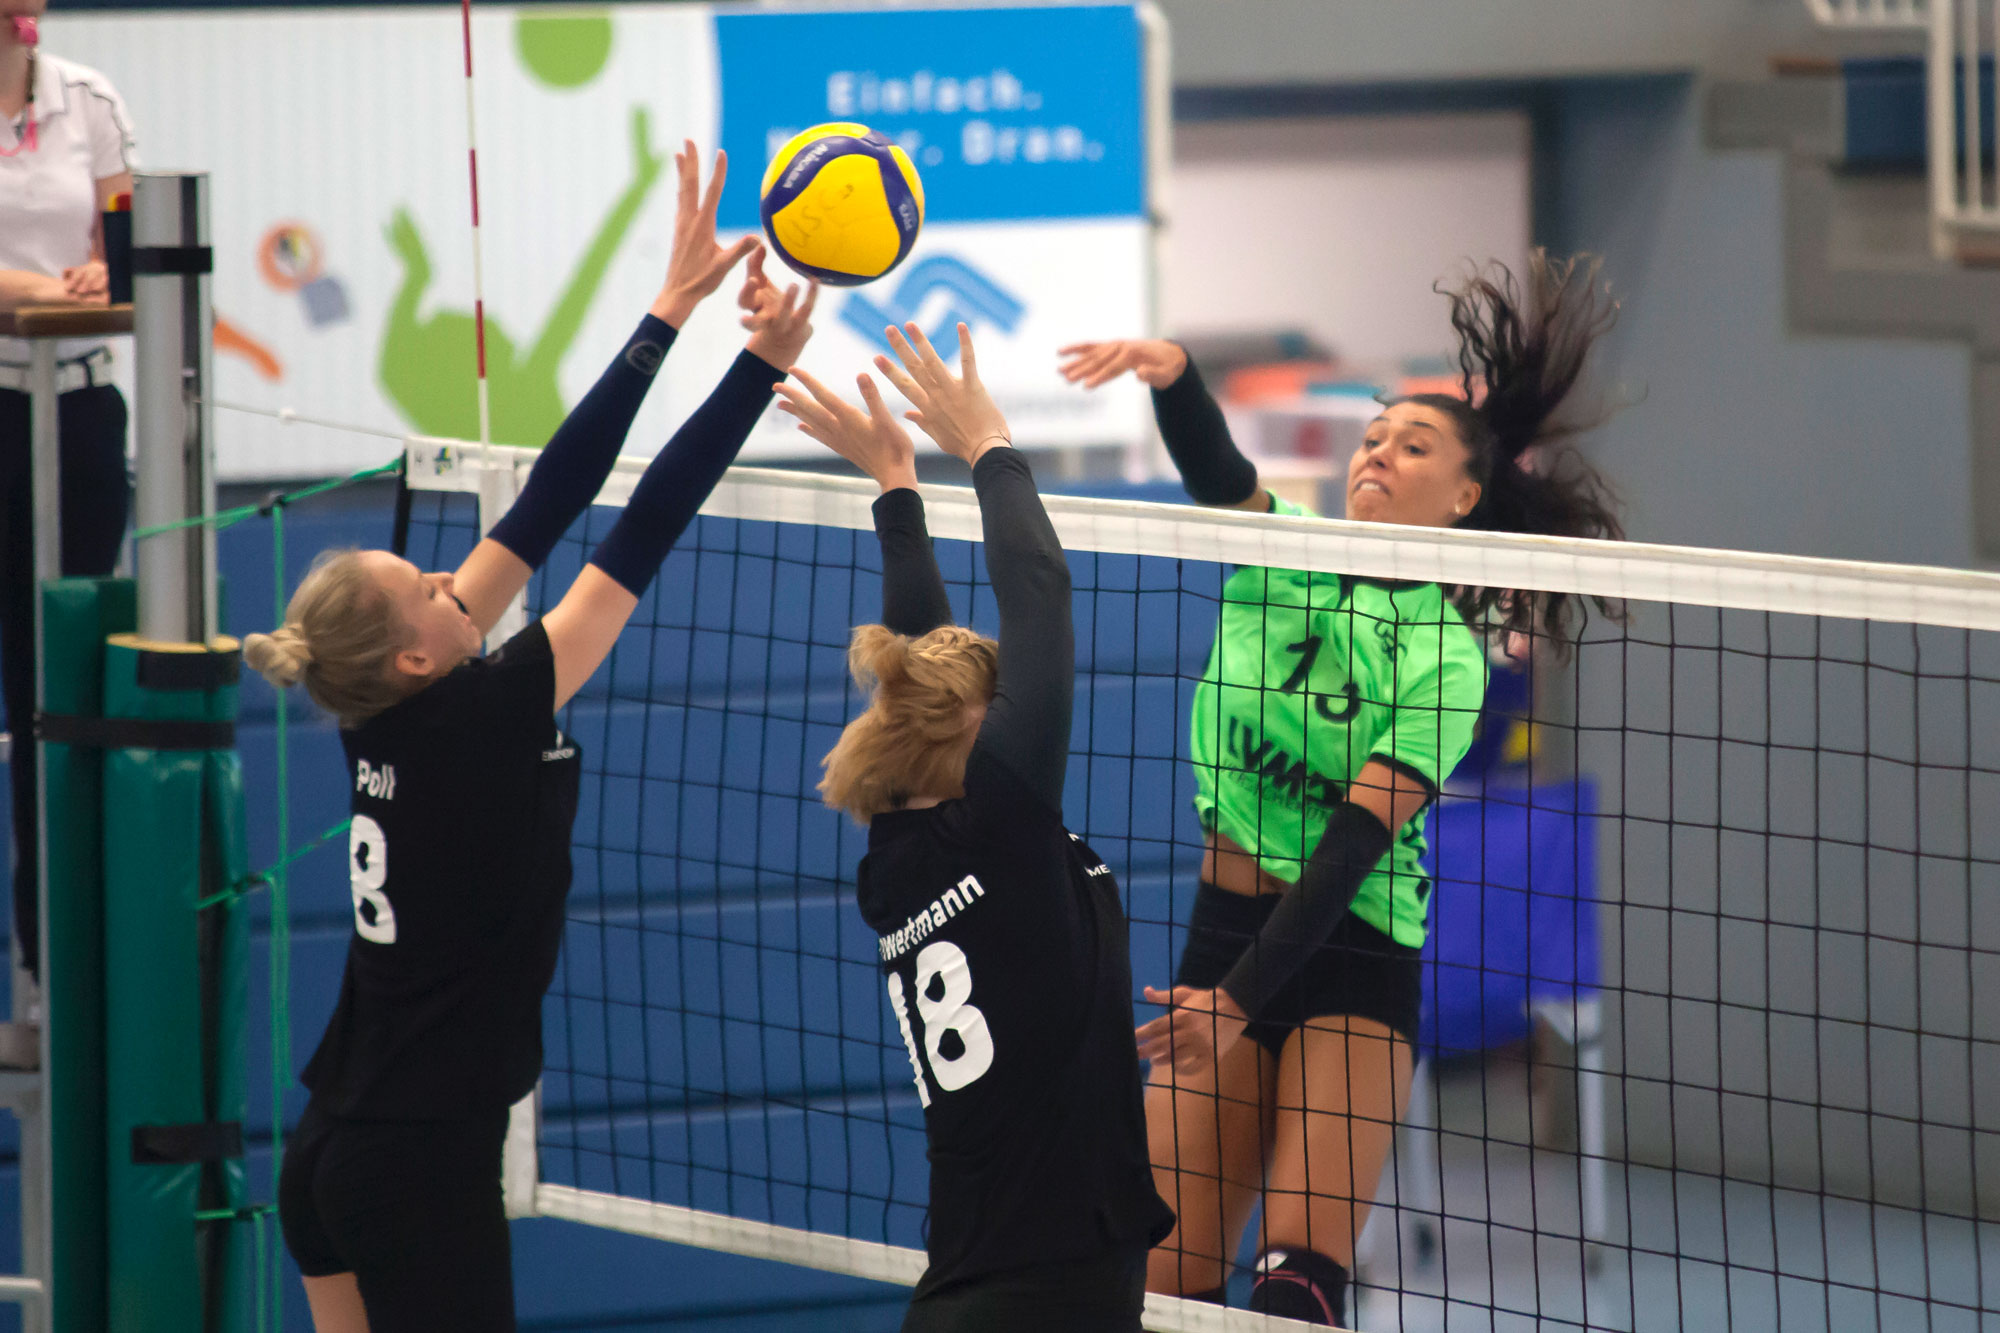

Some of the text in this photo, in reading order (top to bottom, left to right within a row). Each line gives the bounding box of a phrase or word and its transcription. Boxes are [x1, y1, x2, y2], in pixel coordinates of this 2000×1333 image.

[357, 758, 396, 800] Poll
[350, 814, 397, 944] 8
[879, 874, 985, 961] wertmann
[887, 941, 994, 1109] 18
